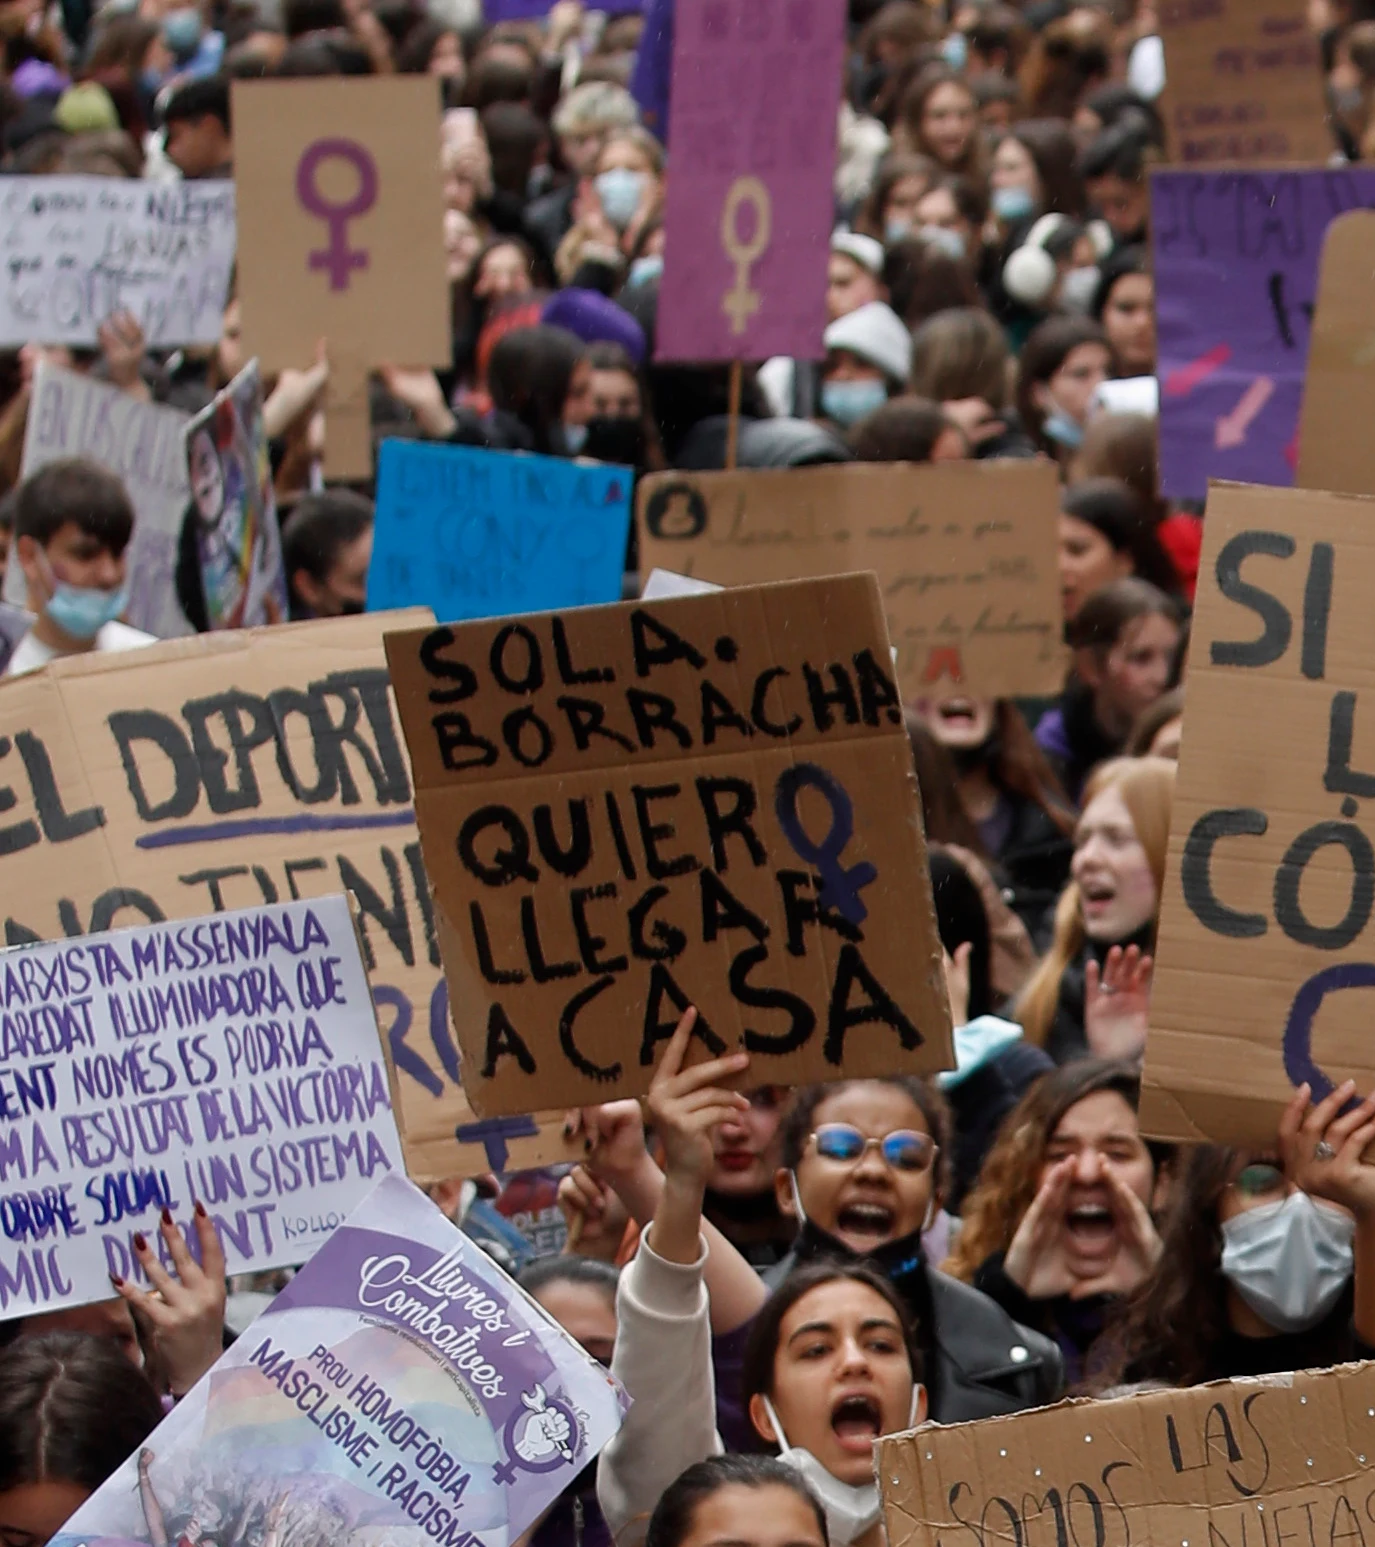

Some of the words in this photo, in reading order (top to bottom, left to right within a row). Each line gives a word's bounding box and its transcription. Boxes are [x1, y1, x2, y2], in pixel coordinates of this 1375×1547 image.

[1209, 530, 1334, 679] SI
[431, 648, 902, 770] BORRACHA
[0, 943, 133, 1009] ARXISTA
[131, 908, 330, 981] M'ASSENYALA
[470, 867, 864, 985] LLEGAR
[297, 956, 347, 1011] QUE
[481, 1003, 537, 1079] A
[559, 942, 925, 1082] CASA
[177, 1033, 218, 1087] ES
[223, 1016, 334, 1079] PODRIA
[61, 1094, 194, 1168] RESULTAT
[85, 1165, 180, 1227] SOCIAL
[197, 1153, 248, 1206] UN
[250, 1130, 393, 1198] SISTEMA
[281, 1211, 347, 1240] KOLLO
[358, 1254, 507, 1399] Combatives
[402, 1240, 510, 1332] Lliures
[249, 1337, 379, 1468] MASCLISME
[307, 1343, 354, 1390] PROU
[1165, 1391, 1270, 1497] LAS
